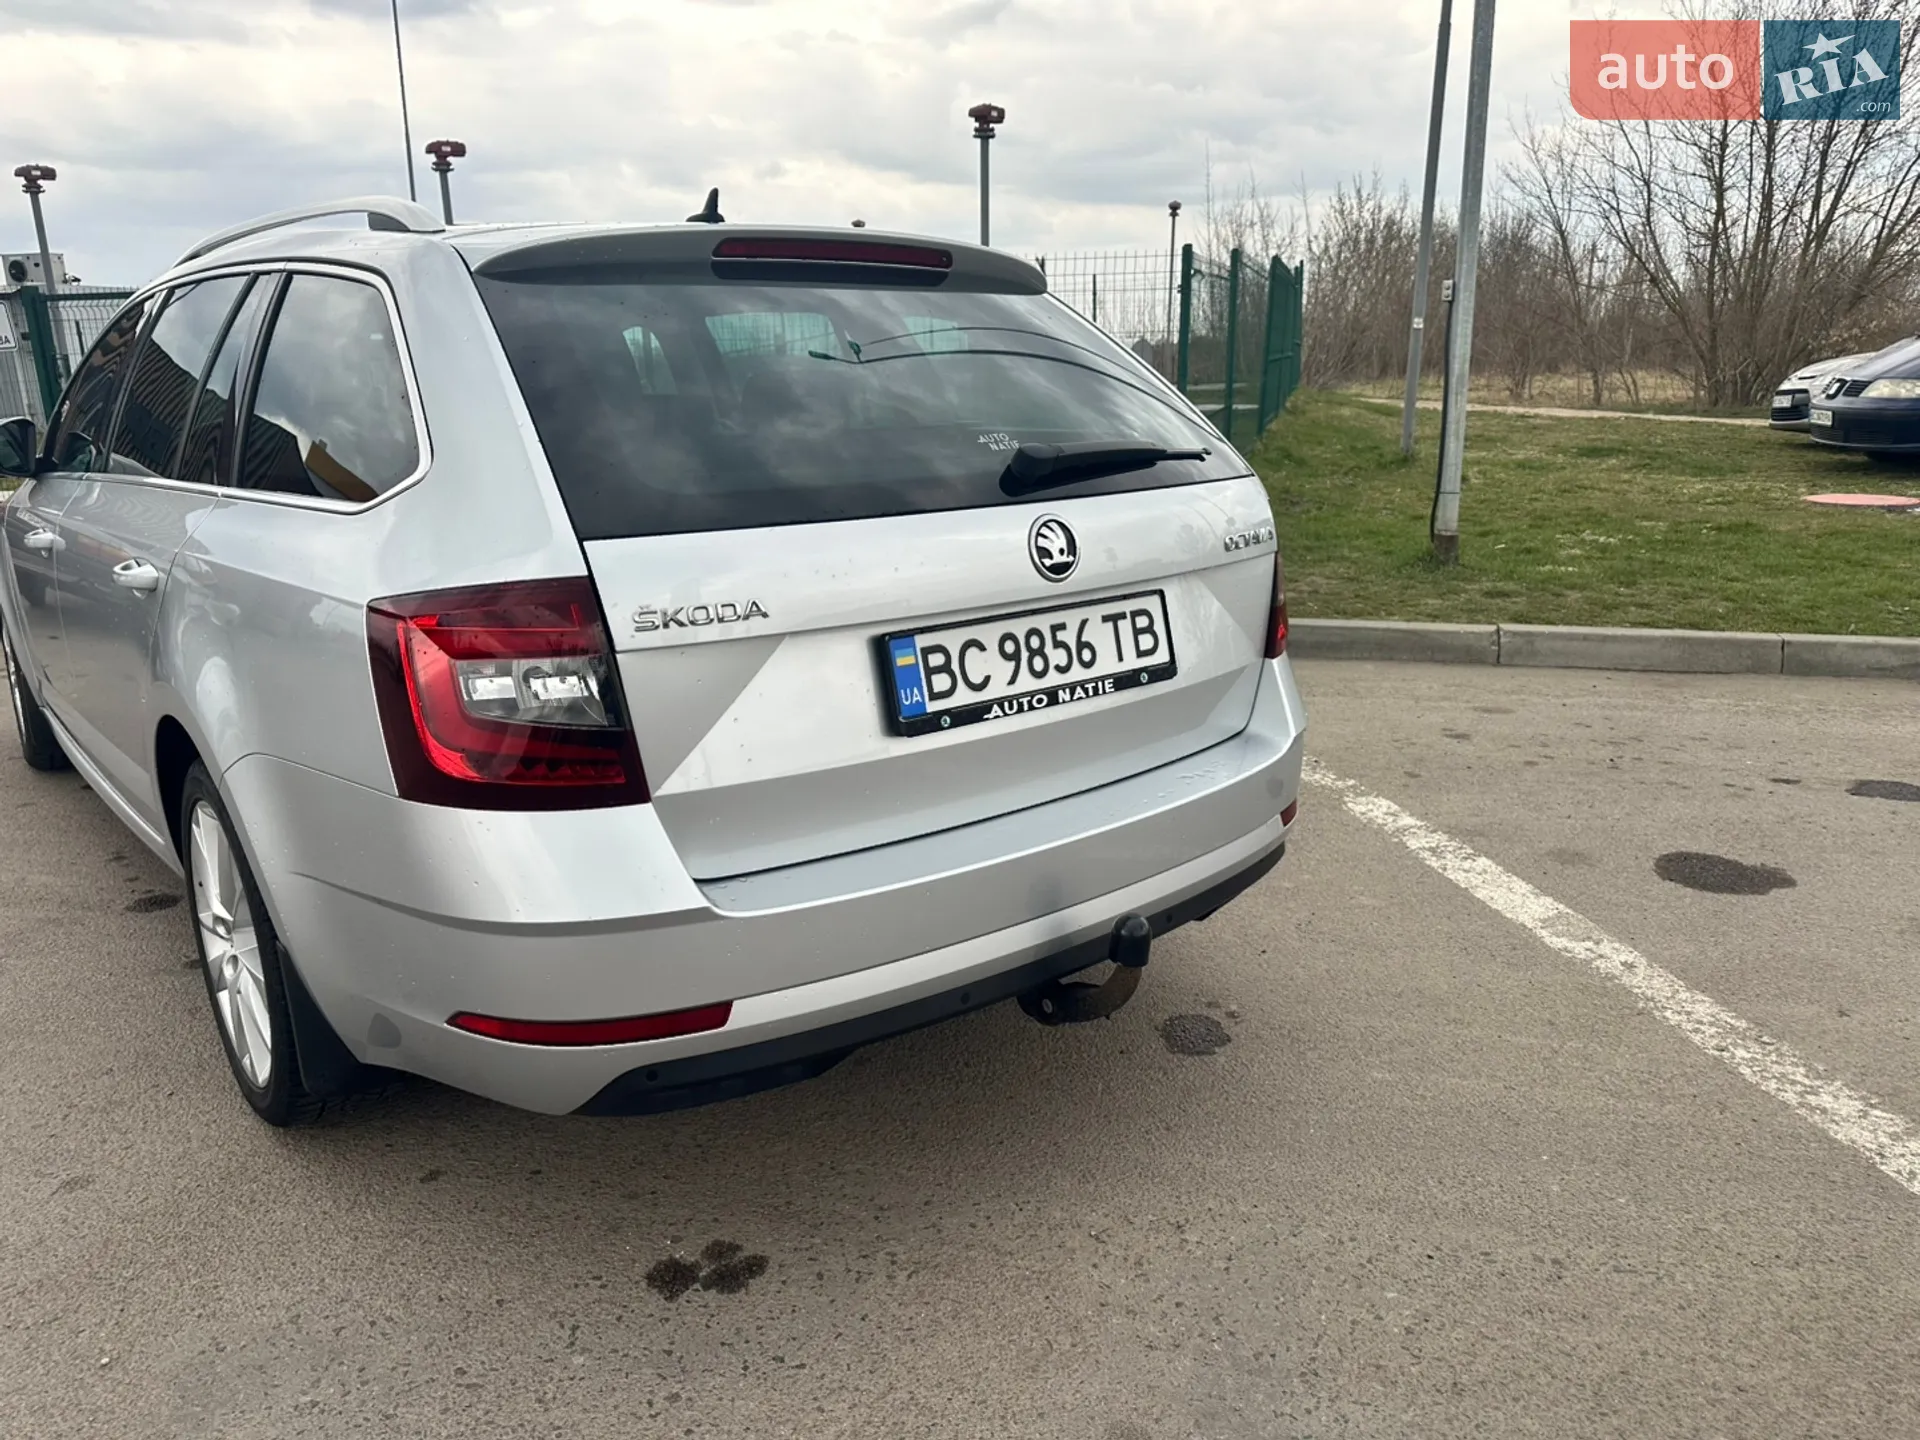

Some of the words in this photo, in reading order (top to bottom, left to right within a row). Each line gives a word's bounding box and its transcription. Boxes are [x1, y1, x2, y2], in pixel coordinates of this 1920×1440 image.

[977, 433, 1010, 443] AUTO
[632, 598, 770, 633] ŠKODA
[920, 638, 992, 702] BC
[998, 618, 1097, 686] 9856
[1101, 608, 1160, 663] TB
[901, 687, 923, 705] UA
[983, 694, 1048, 720] AUTO
[1058, 678, 1115, 703] NATIE
